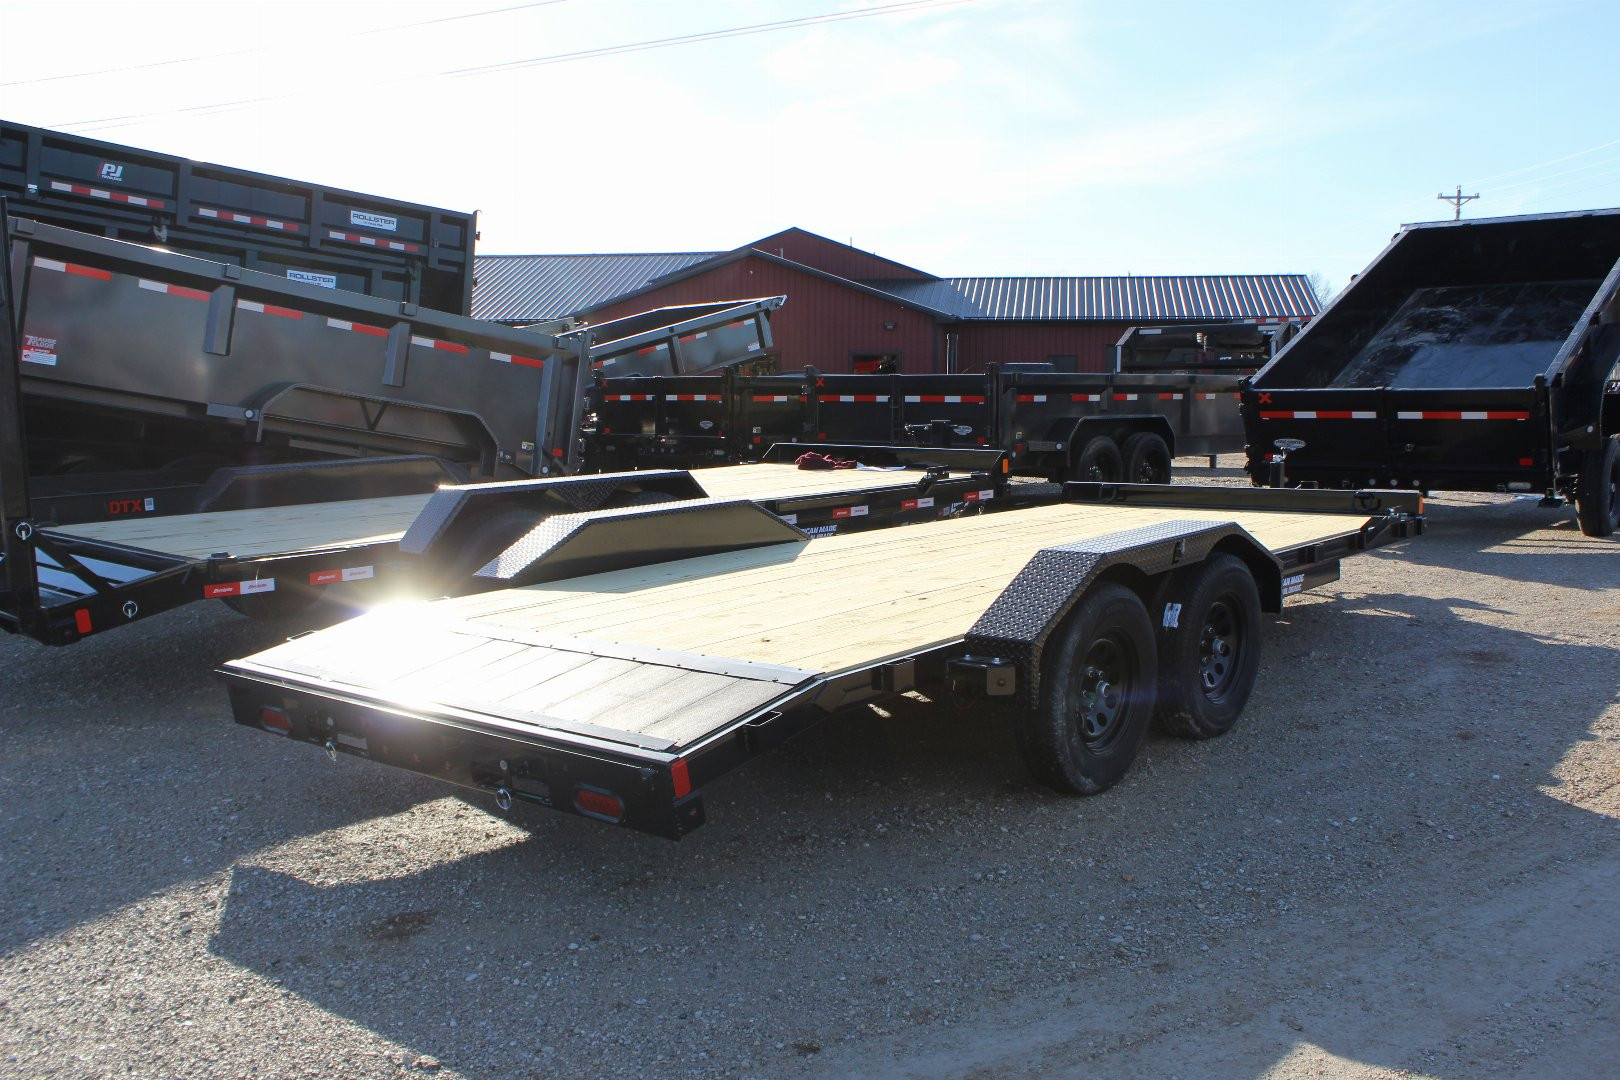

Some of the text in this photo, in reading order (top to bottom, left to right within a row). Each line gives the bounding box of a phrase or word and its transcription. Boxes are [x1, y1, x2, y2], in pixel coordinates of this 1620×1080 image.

[102, 163, 123, 178] PJ
[289, 272, 335, 284] ROLLSTER
[32, 336, 57, 345] GAUGE
[109, 499, 143, 515] DTX
